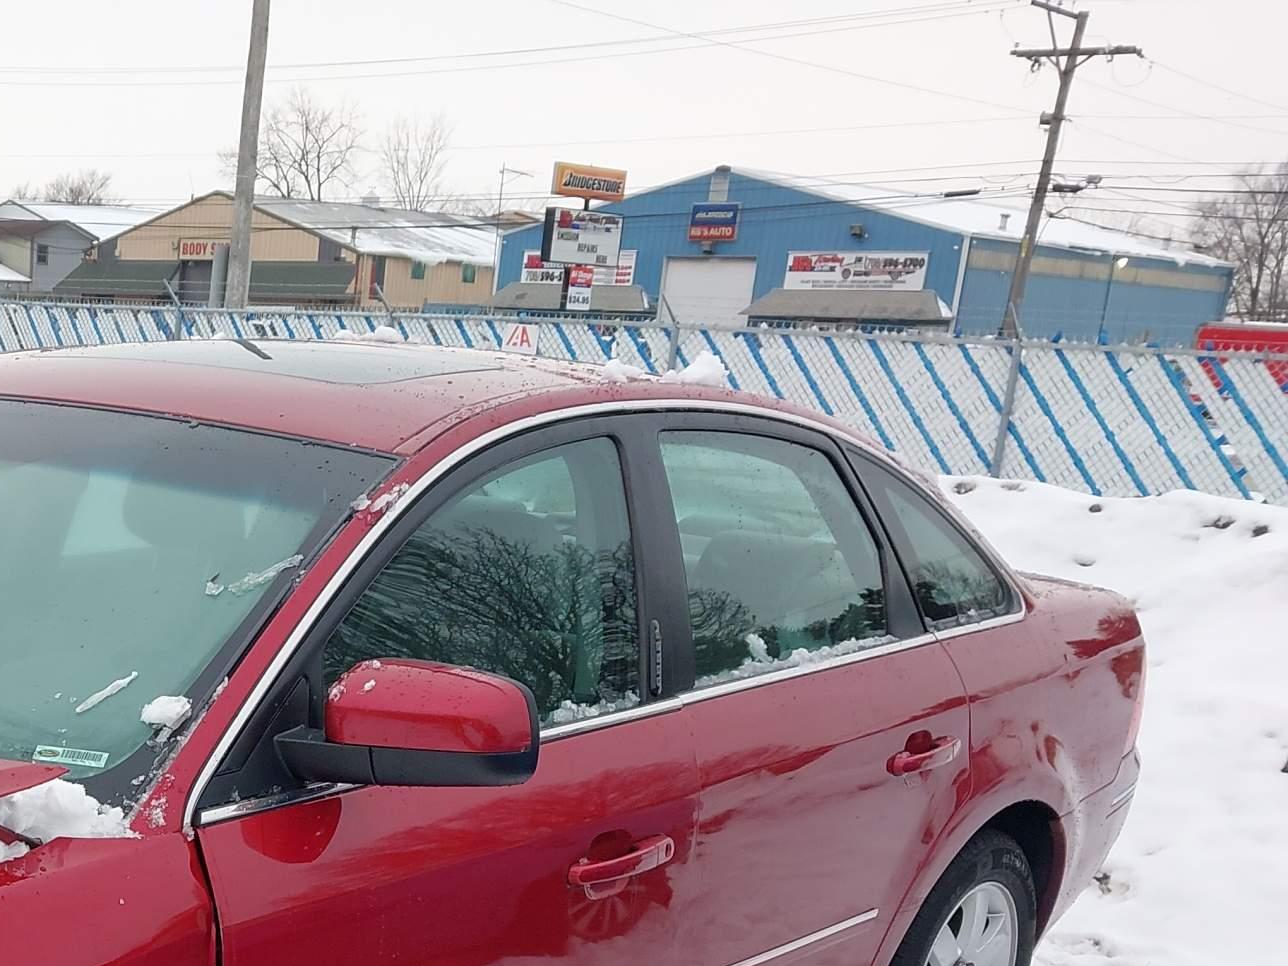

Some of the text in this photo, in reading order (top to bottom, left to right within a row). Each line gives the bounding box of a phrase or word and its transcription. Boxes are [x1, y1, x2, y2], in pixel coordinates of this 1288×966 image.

[563, 172, 623, 194] BRIDGESTONE
[709, 226, 733, 236] AUTO
[182, 242, 208, 256] BODY
